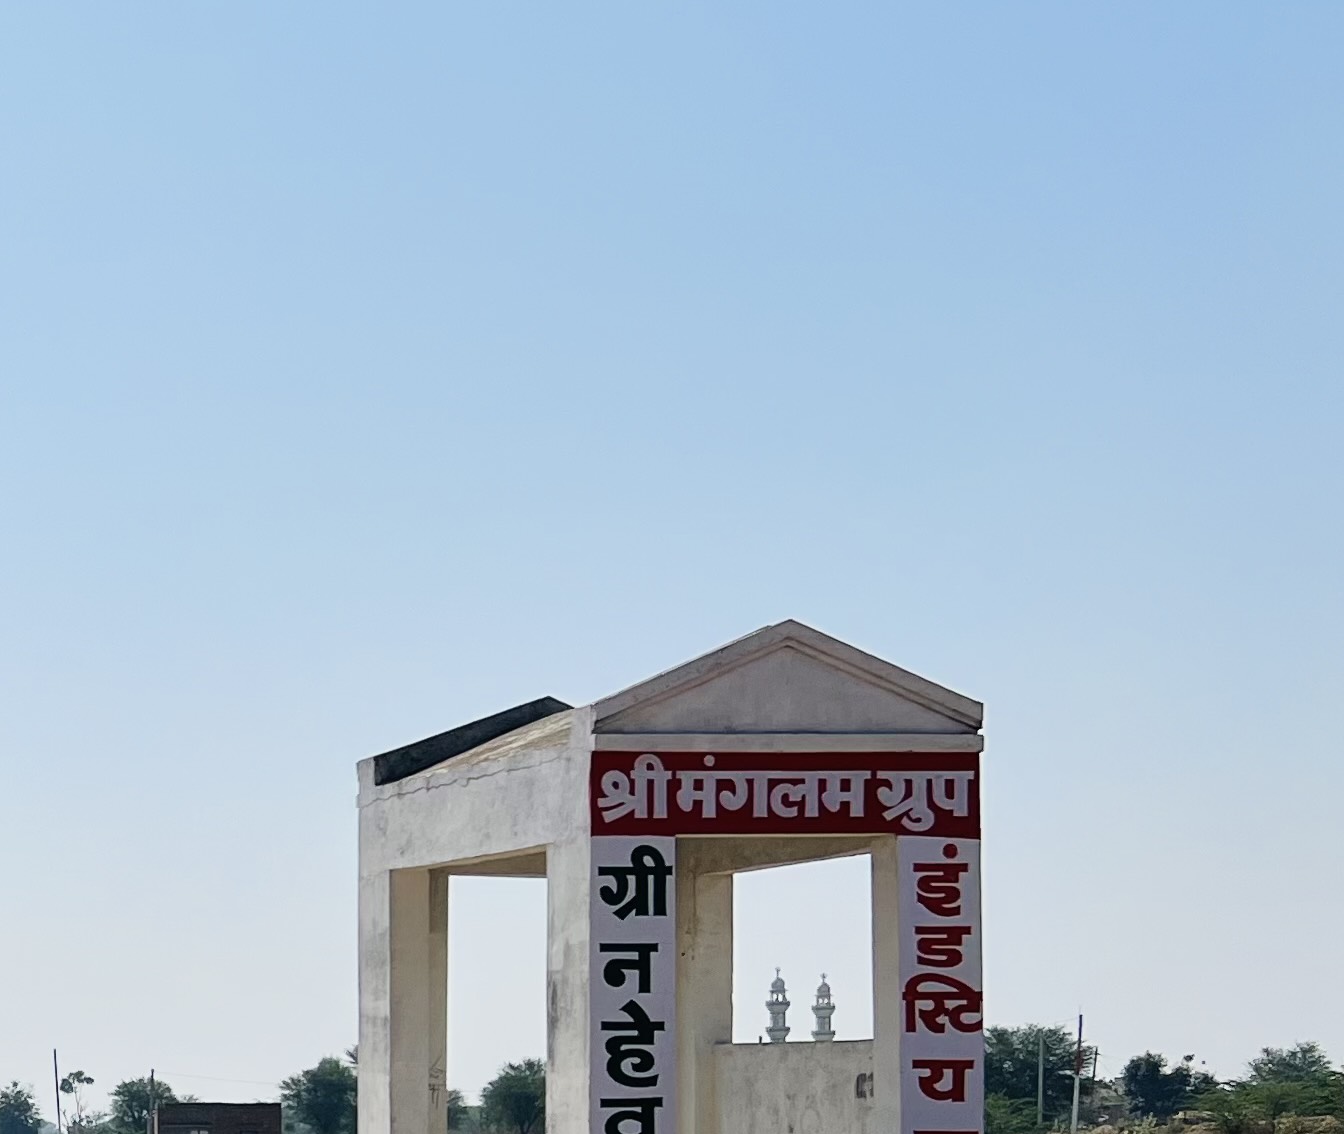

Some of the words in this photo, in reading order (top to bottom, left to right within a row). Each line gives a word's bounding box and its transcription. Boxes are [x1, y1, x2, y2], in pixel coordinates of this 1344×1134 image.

[597, 753, 673, 823] श्री
[675, 753, 872, 819] मंगलम
[876, 769, 975, 832] ग्रुप
